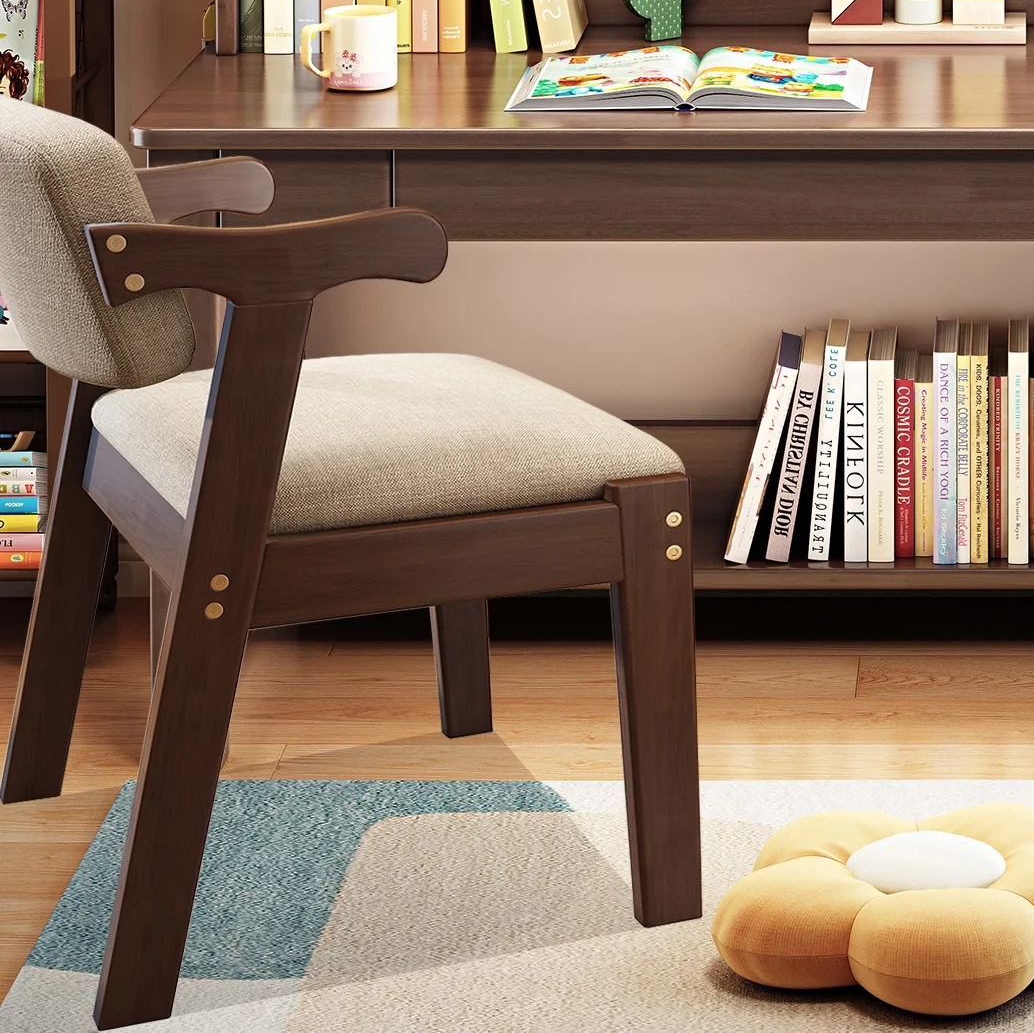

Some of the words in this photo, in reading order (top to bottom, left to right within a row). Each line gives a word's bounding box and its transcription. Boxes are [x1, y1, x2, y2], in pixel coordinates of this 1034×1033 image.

[939, 364, 949, 403] DANCE
[958, 368, 968, 383] FIRE
[957, 392, 968, 406] the
[897, 386, 910, 442] COSMIC
[940, 407, 949, 424] OF
[940, 427, 949, 436] A
[958, 407, 968, 453] CORPORATE
[940, 440, 949, 467] RICH
[958, 454, 968, 477] BELLY
[897, 446, 911, 505] CRADLE
[940, 472, 949, 500] YOGI
[941, 508, 947, 520] Ed
[958, 498, 968, 512] Tom
[939, 523, 948, 556] Beckley
[958, 514, 968, 547] FitzGerald
